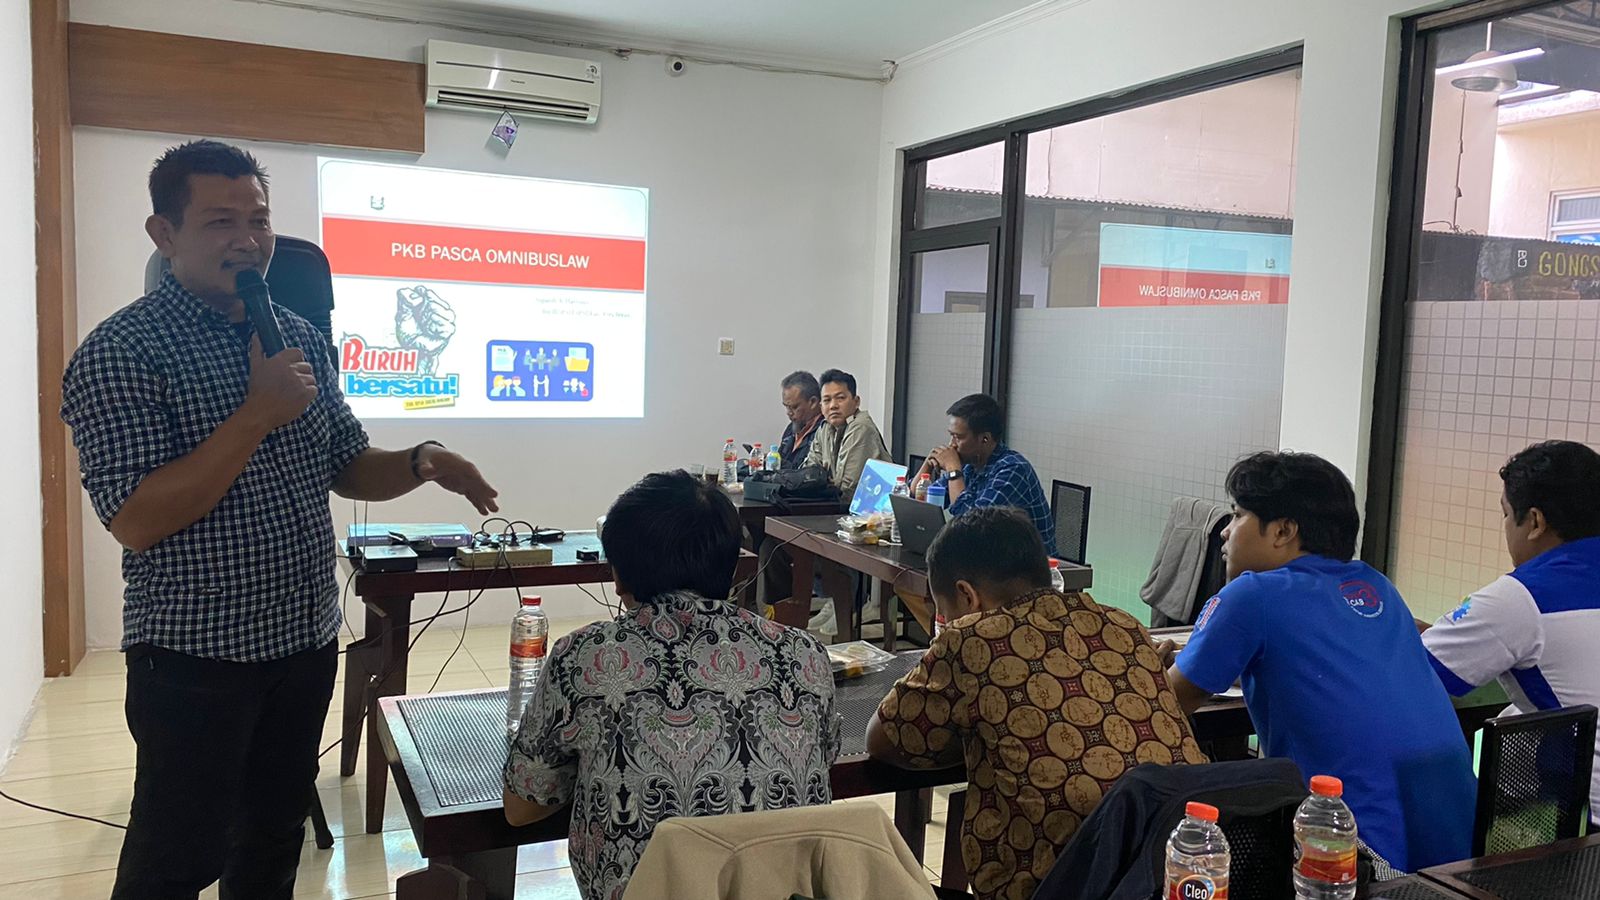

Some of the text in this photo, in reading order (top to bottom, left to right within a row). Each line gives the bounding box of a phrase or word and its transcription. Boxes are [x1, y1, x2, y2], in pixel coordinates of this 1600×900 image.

[391, 242, 590, 269] PKB PASCA OMNIBUSLAW
[342, 338, 417, 371] BURUH
[347, 374, 457, 395] bersatu!
[1185, 883, 1208, 900] Cleo
